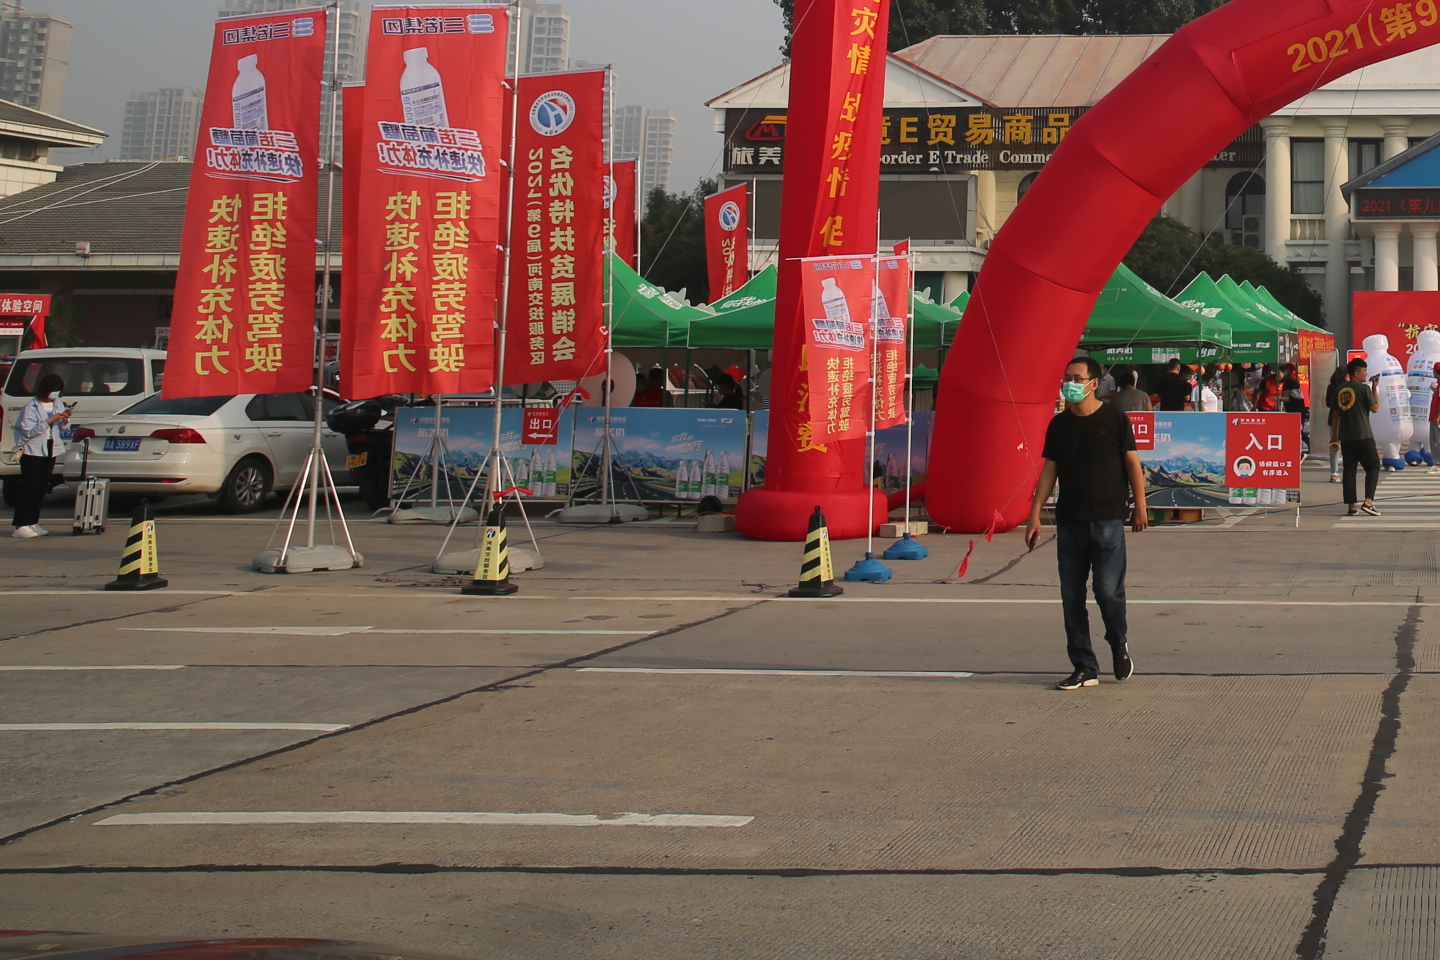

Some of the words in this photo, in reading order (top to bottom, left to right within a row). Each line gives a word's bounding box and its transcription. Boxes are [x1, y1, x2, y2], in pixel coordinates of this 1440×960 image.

[731, 146, 782, 165] 旅美
[879, 151, 923, 165] order
[928, 150, 940, 164] E
[944, 150, 990, 165] Trade
[0, 299, 43, 313] 体验空间
[529, 418, 553, 429] 出口
[1244, 433, 1283, 450] 入口
